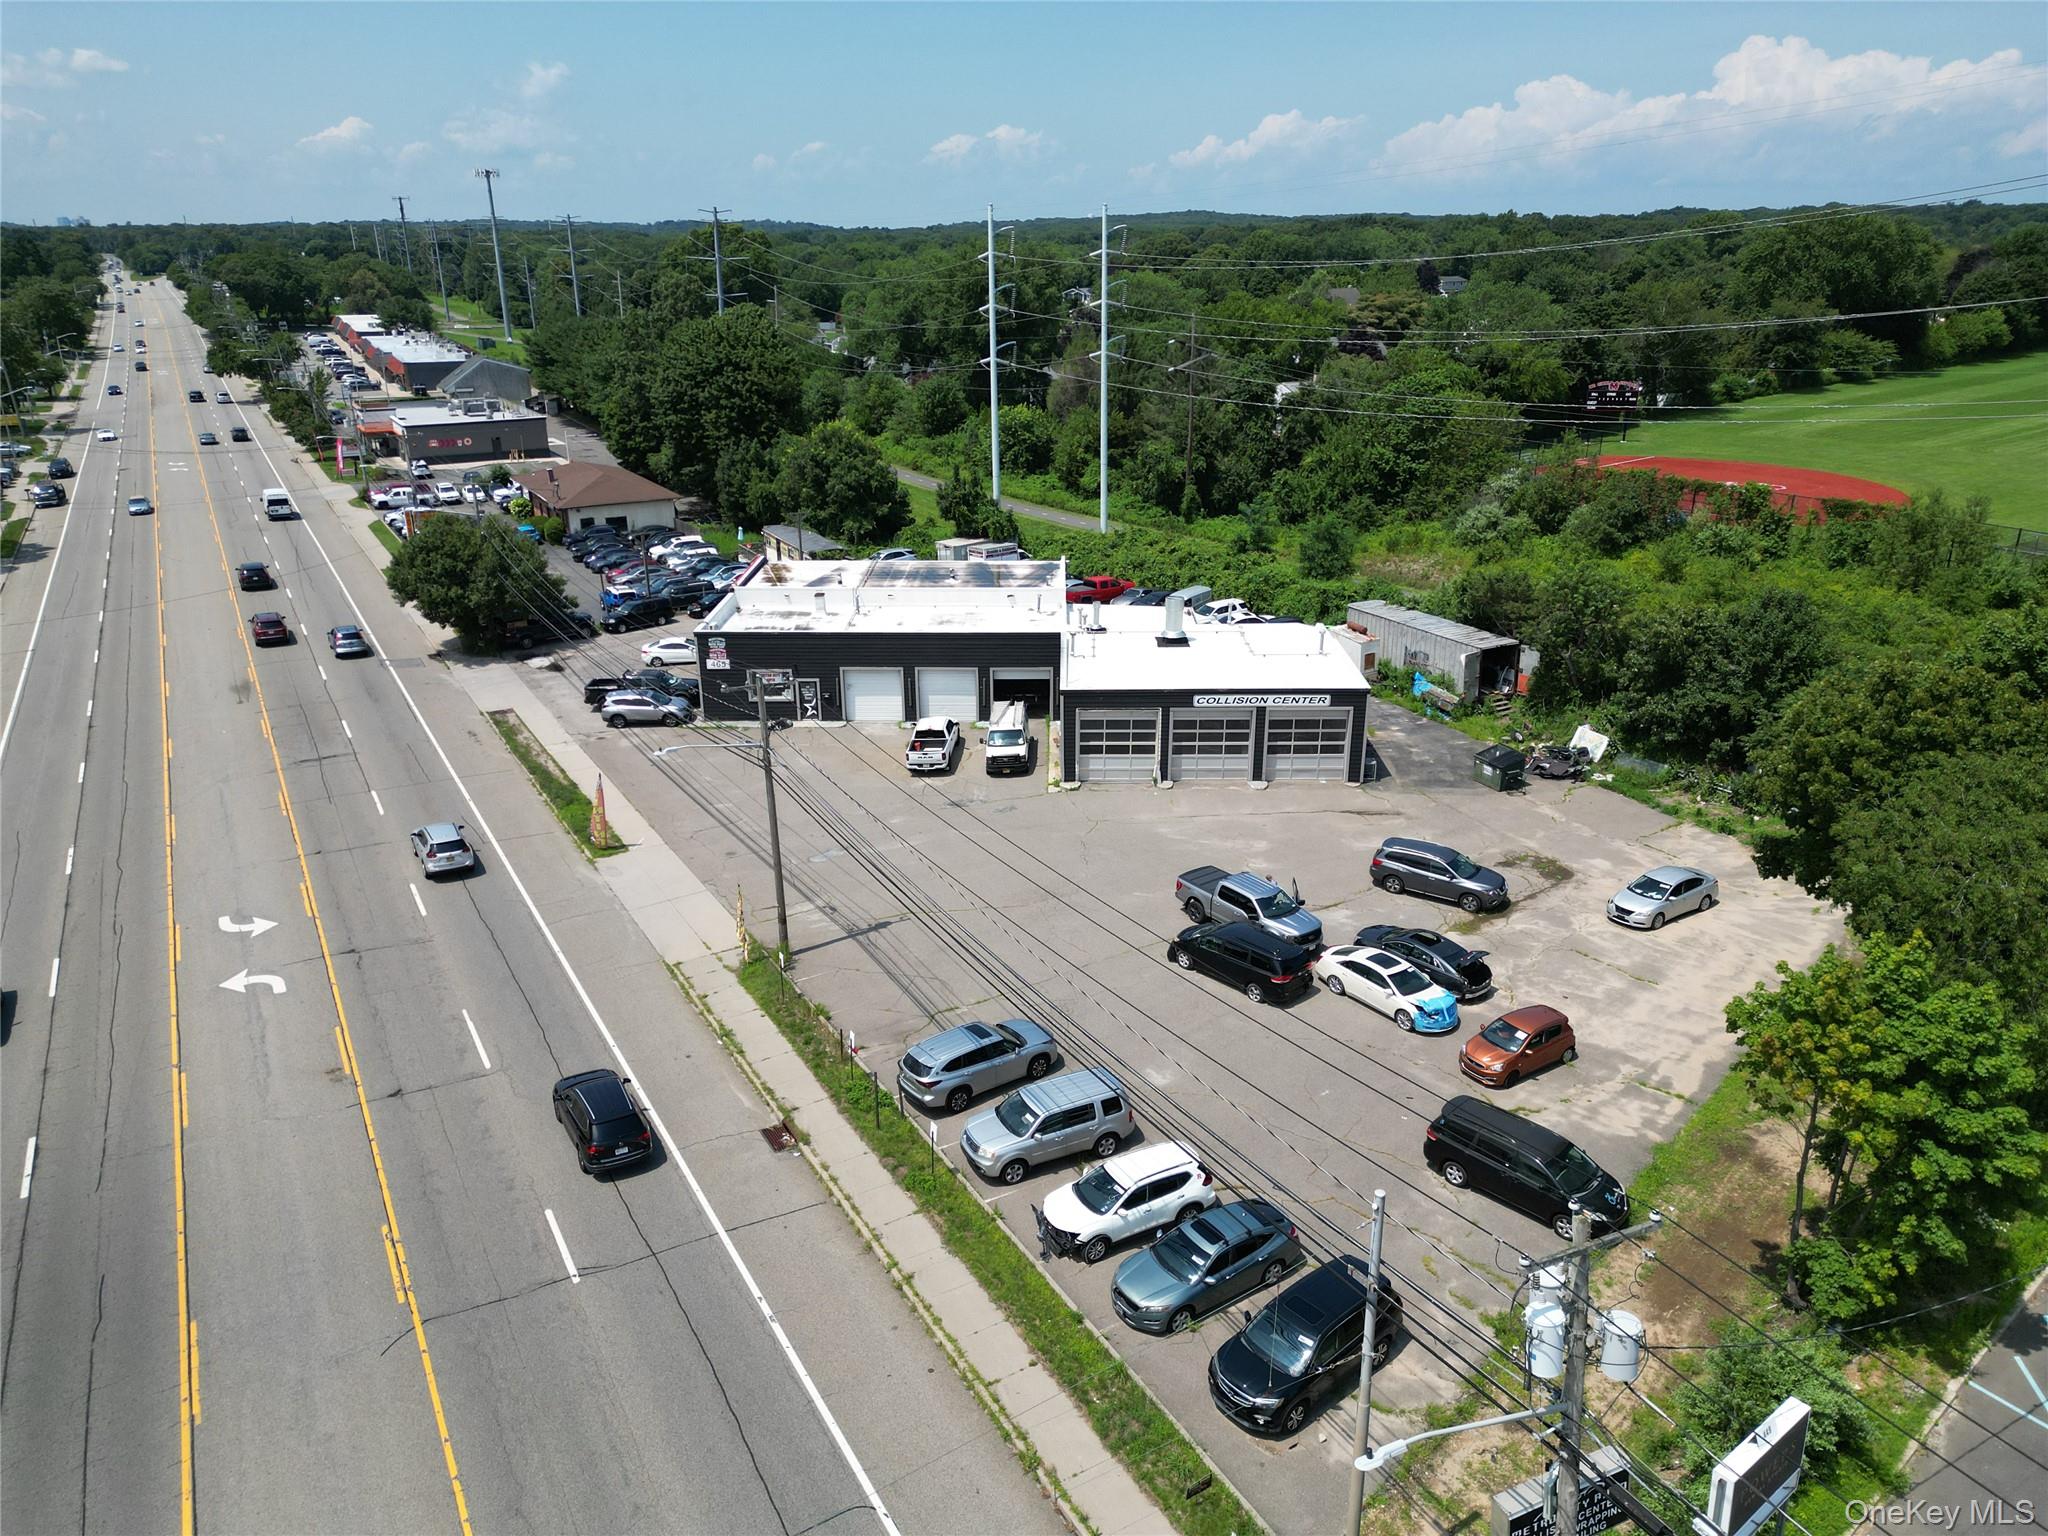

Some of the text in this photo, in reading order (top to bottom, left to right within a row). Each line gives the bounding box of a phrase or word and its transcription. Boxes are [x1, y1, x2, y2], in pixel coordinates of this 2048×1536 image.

[1196, 696, 1328, 705] COLLISION CENTER
[1578, 1500, 1614, 1520] CENTE
